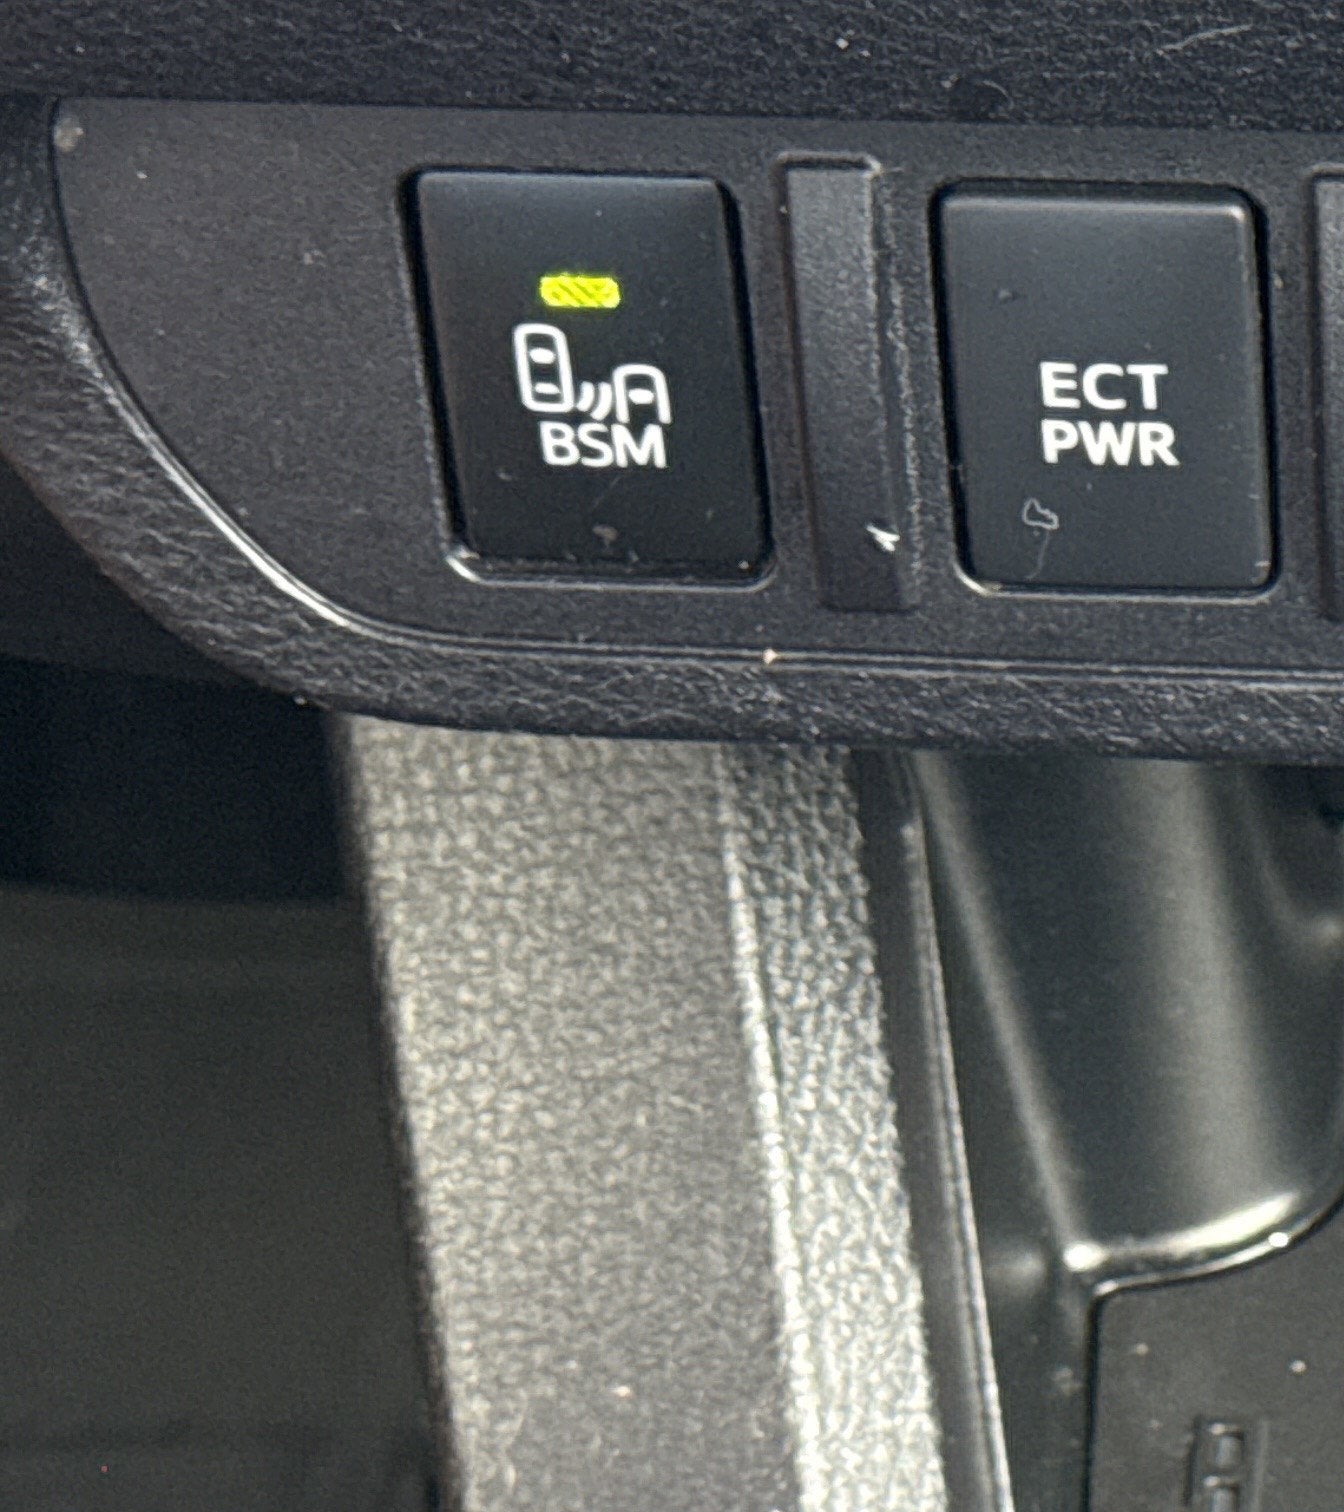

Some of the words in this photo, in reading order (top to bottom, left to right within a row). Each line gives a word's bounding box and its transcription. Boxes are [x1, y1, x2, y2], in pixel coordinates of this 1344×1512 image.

[1040, 361, 1169, 410] ECT
[539, 421, 668, 469] BSM
[1040, 419, 1181, 467] PWR
